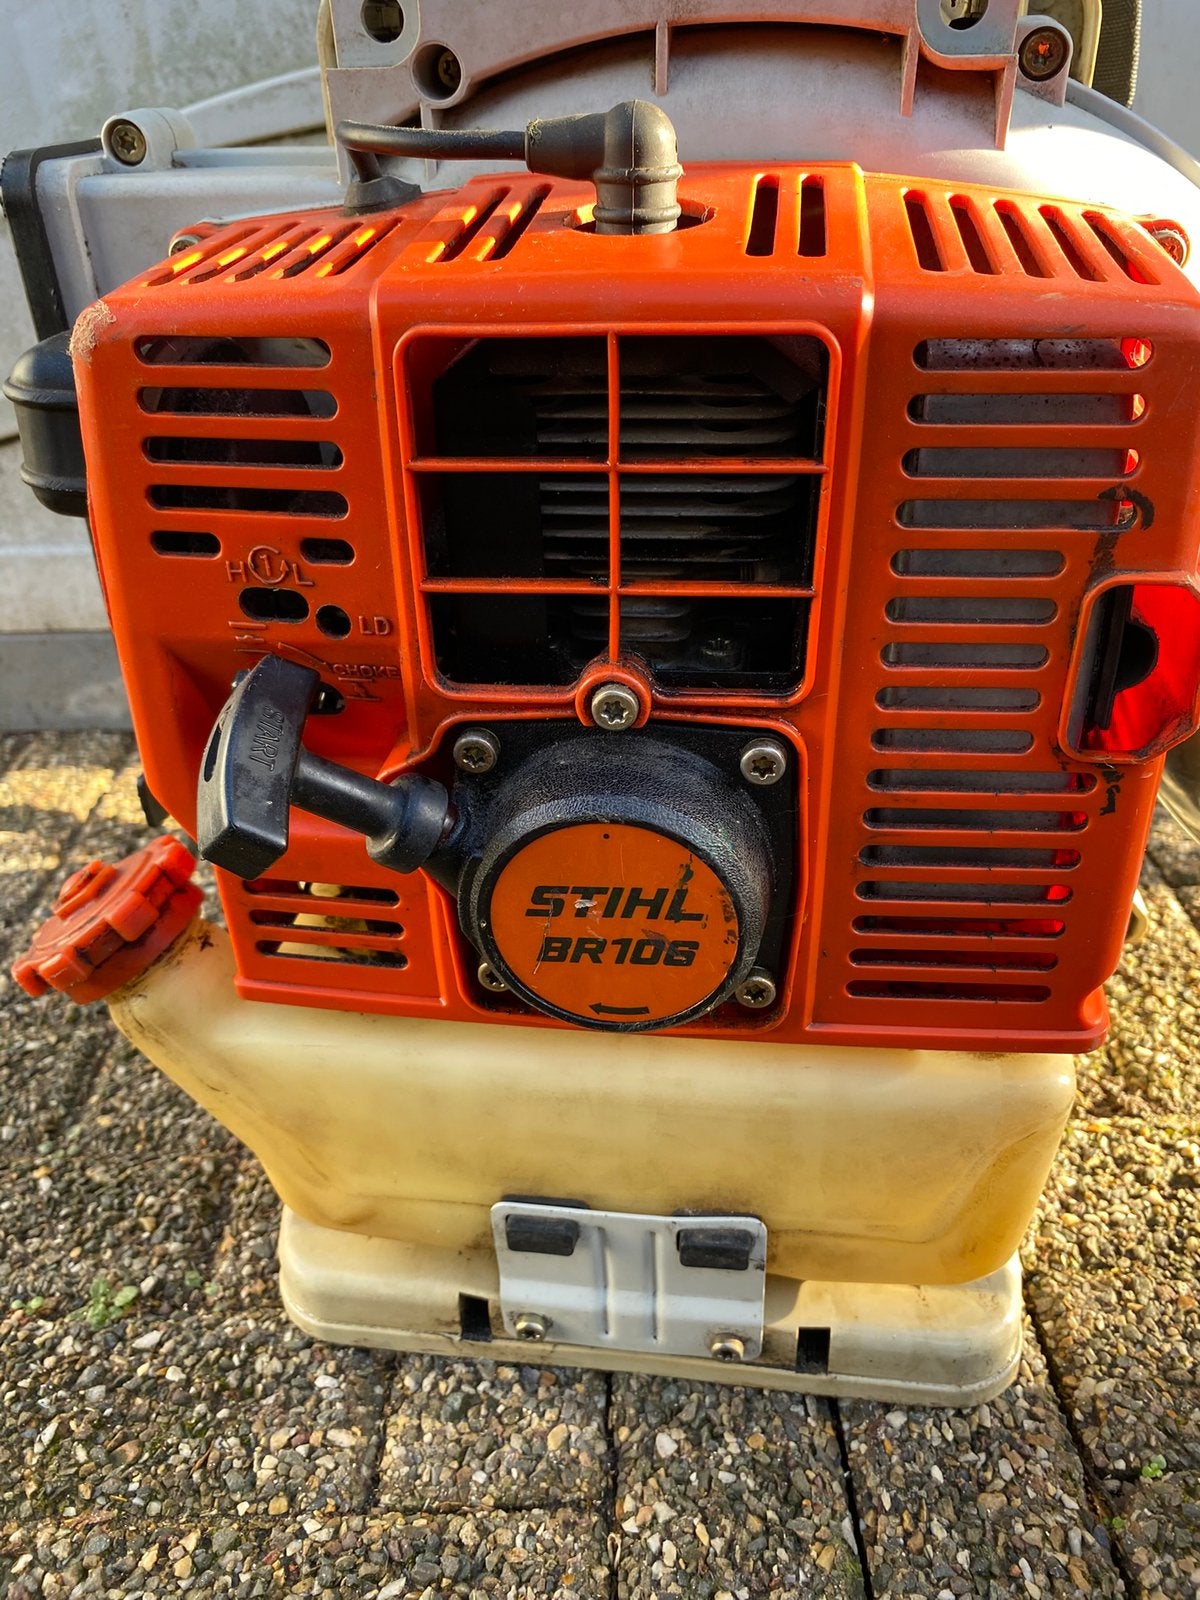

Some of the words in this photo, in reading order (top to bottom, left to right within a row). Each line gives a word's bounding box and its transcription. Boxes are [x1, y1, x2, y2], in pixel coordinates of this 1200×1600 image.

[225, 560, 247, 583] H
[292, 563, 315, 587] L
[358, 615, 392, 636] LD
[331, 662, 400, 680] CHOKE
[249, 704, 285, 773] START
[525, 885, 705, 923] STIHL
[536, 936, 700, 967] BR106
